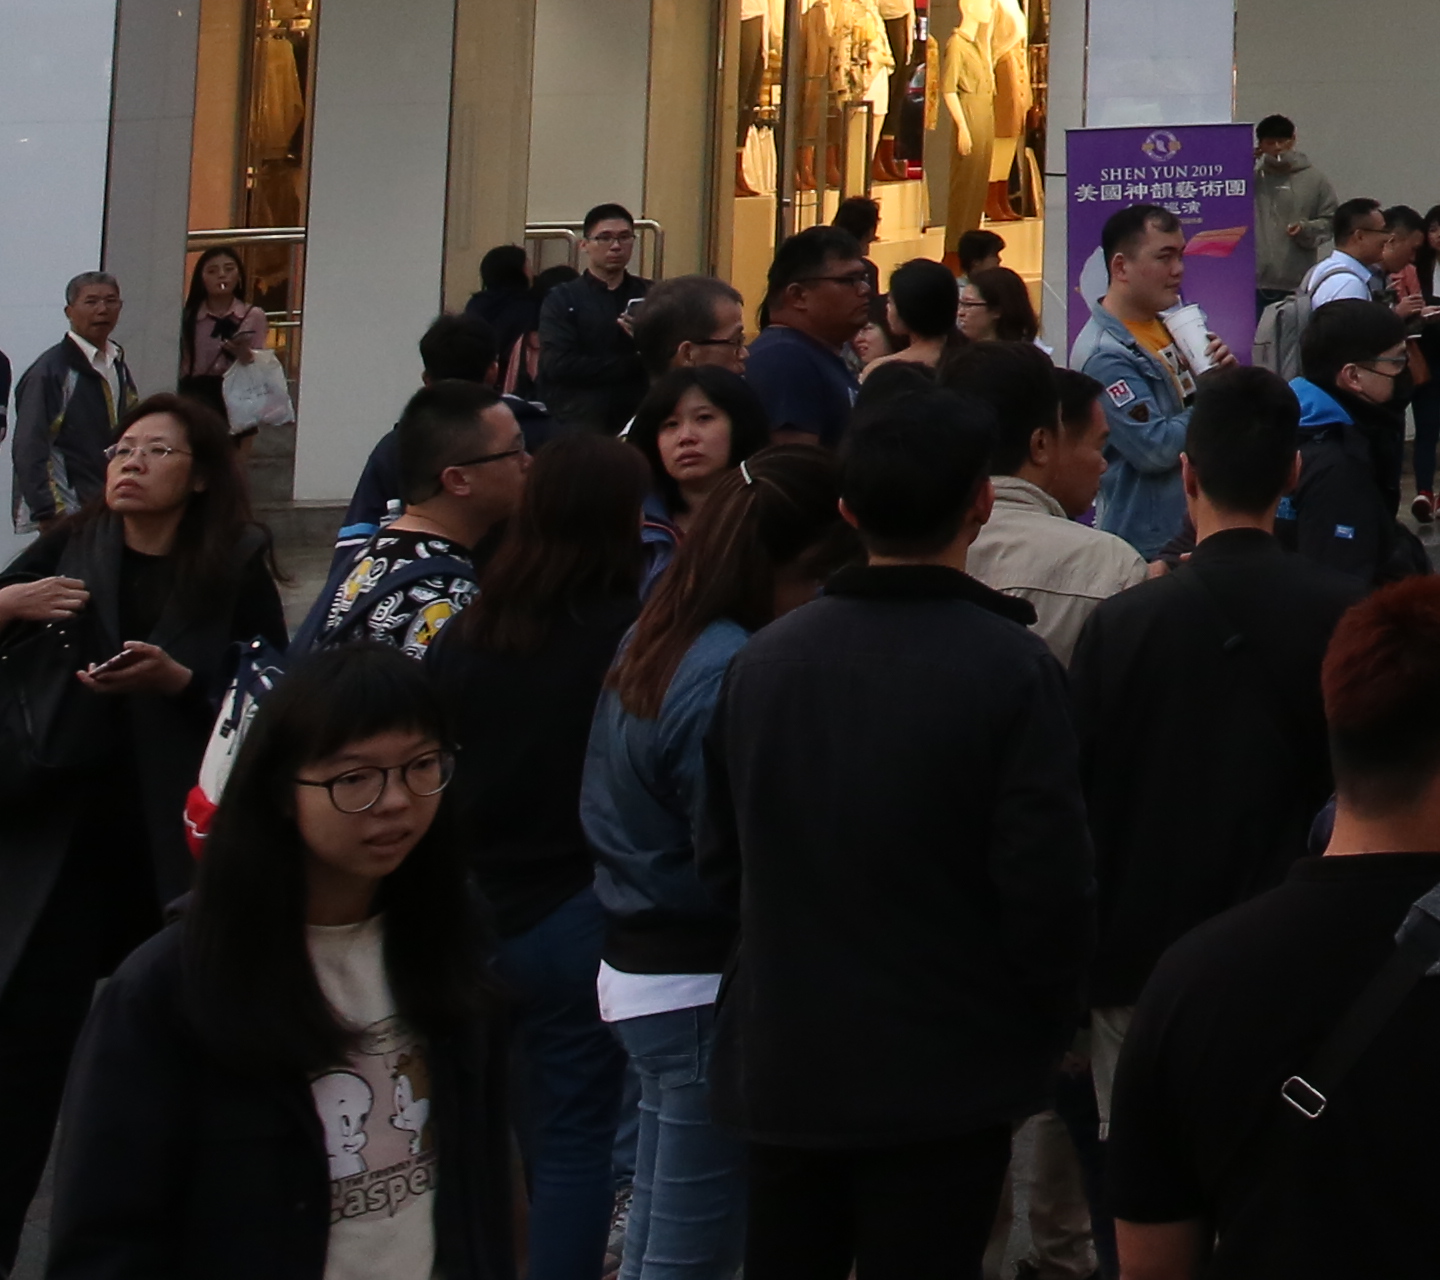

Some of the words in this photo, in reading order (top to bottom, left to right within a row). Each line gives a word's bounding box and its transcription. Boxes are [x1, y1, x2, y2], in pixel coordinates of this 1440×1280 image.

[1100, 167, 1146, 182] SHEN
[1152, 165, 1188, 179] YUN
[1192, 164, 1223, 177] 2019
[1075, 179, 1246, 202] 美國神韻藝術團
